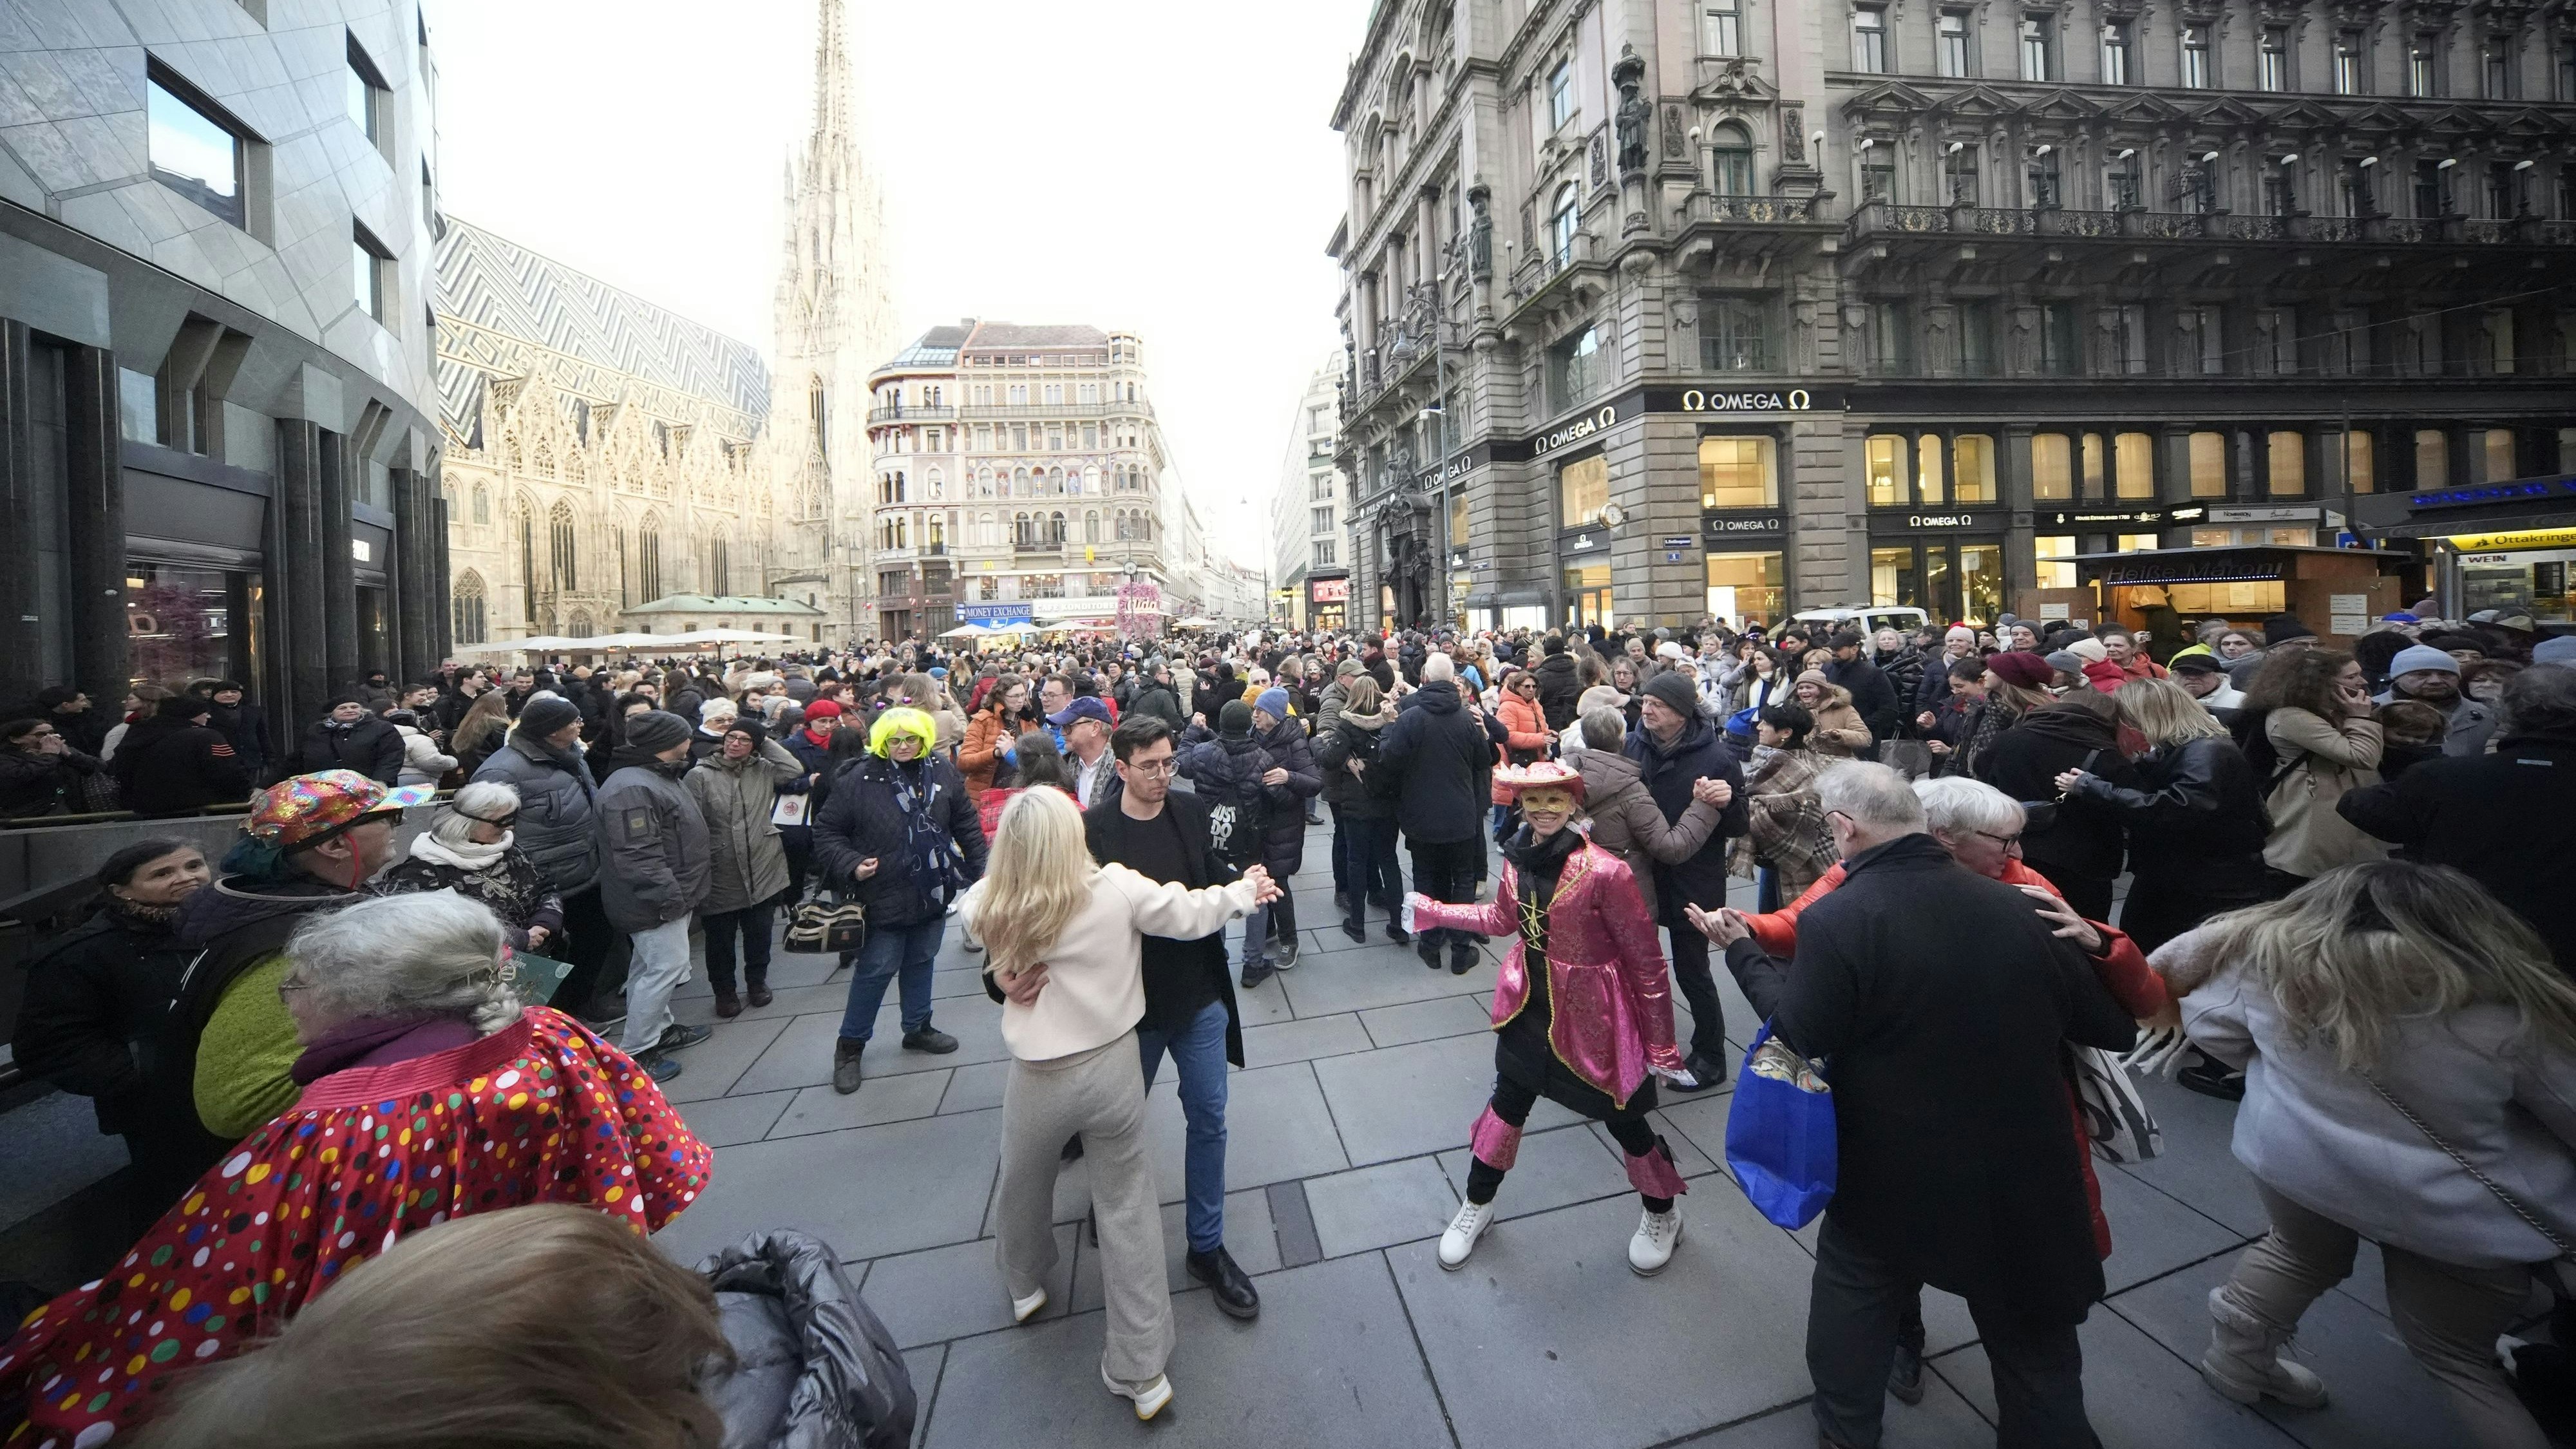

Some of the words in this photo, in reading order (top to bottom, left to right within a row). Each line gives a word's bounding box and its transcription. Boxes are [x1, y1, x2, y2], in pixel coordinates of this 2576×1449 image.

[1710, 393, 1783, 410] OMEGA
[1550, 418, 1596, 448] OMEGA
[1434, 464, 1461, 487] OMGA
[1727, 521, 1765, 530] OMEGA
[1923, 516, 1958, 526] OMEGA
[967, 607, 991, 617] MONEY
[993, 605, 1030, 616] EXCHANGE
[1210, 803, 1236, 823] JUST
[1210, 819, 1233, 838] DO
